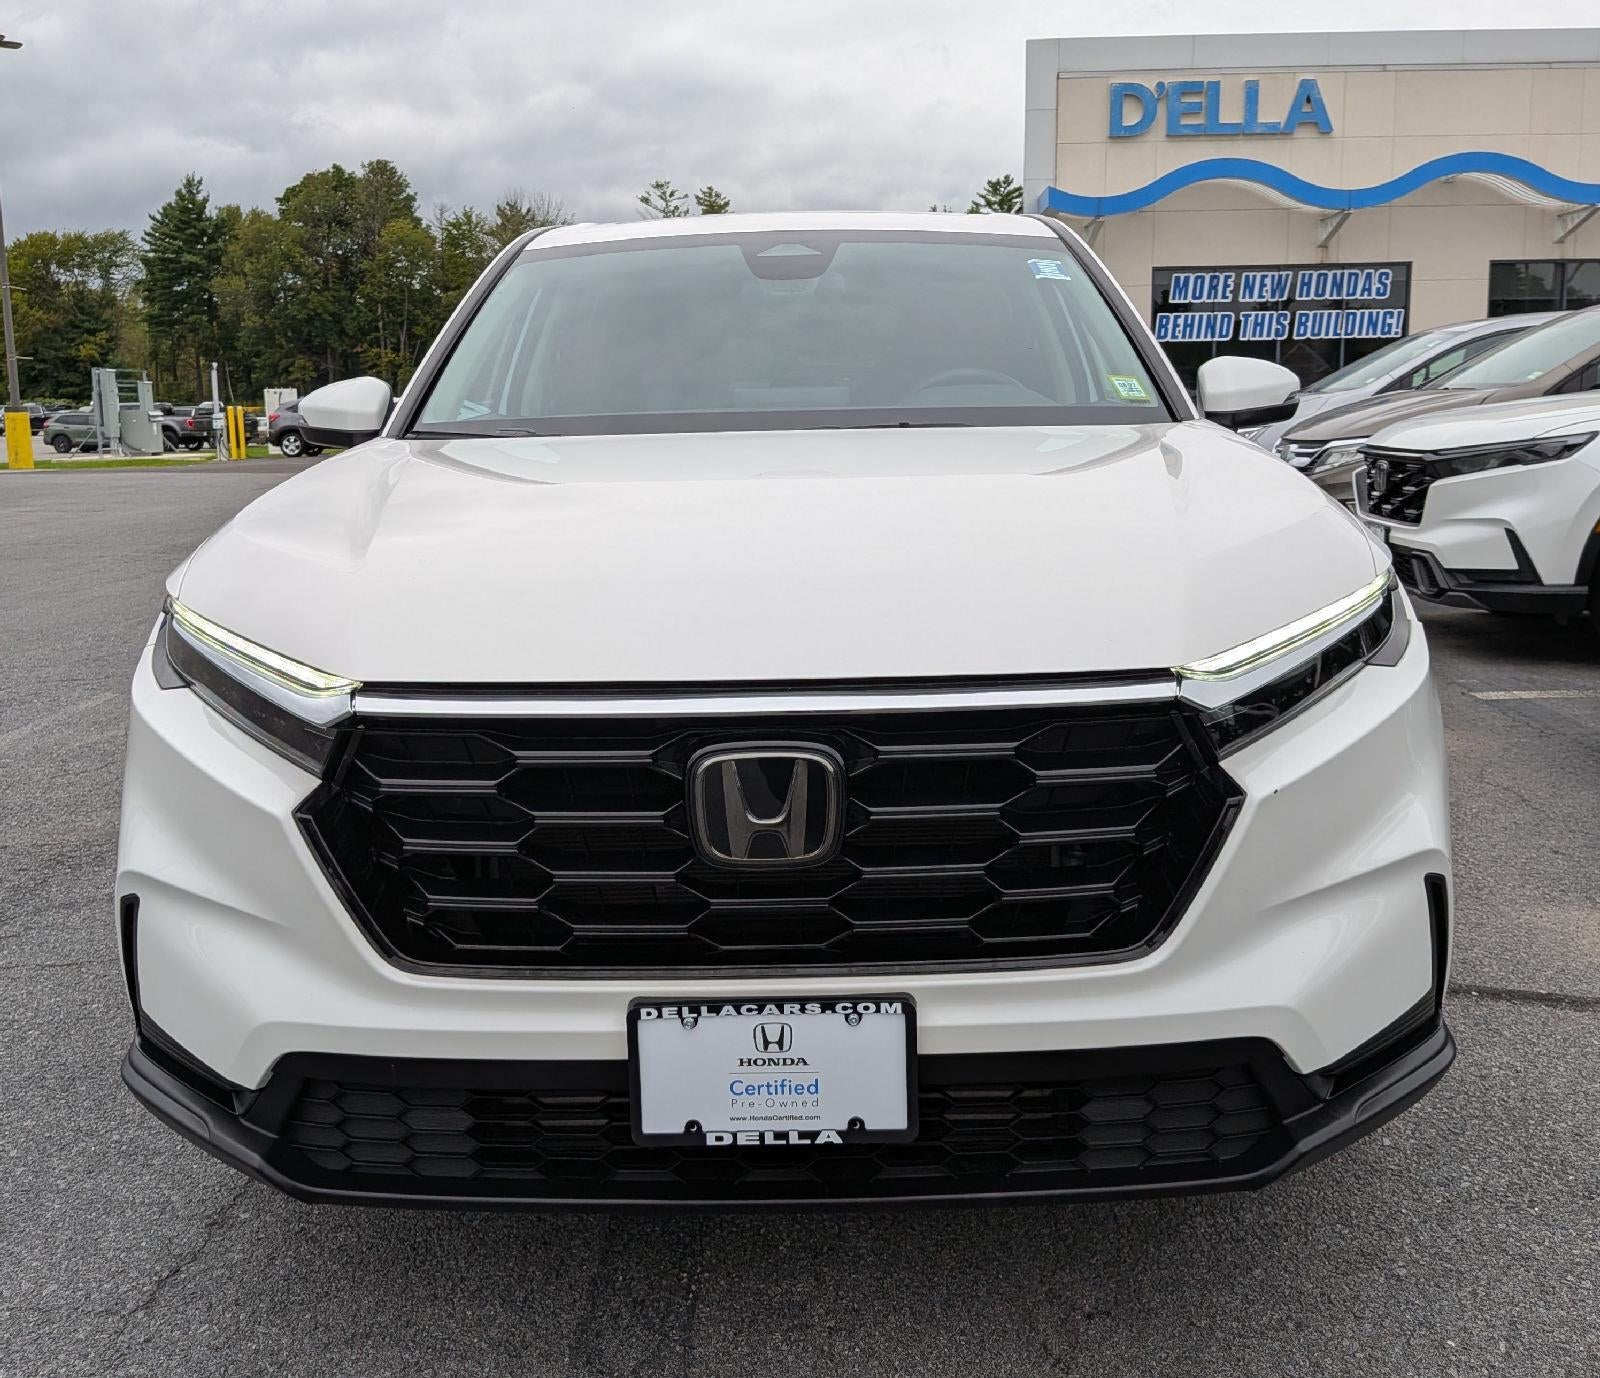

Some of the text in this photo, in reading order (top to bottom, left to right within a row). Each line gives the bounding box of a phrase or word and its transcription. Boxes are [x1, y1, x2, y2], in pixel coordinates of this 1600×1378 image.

[1109, 79, 1333, 137] D'ELLA
[1169, 269, 1392, 303] MORE NEW HONDAS
[1155, 308, 1404, 342] BEHIND THIS BUILDING!
[639, 1002, 902, 1020] DELLACARS.COM
[738, 1057, 810, 1067] HONDA
[729, 1078, 820, 1097] Certified
[731, 1098, 820, 1109] Pre-Owned
[729, 1113, 821, 1122] www.HondaCertified.com
[705, 1129, 844, 1146] DELLA
